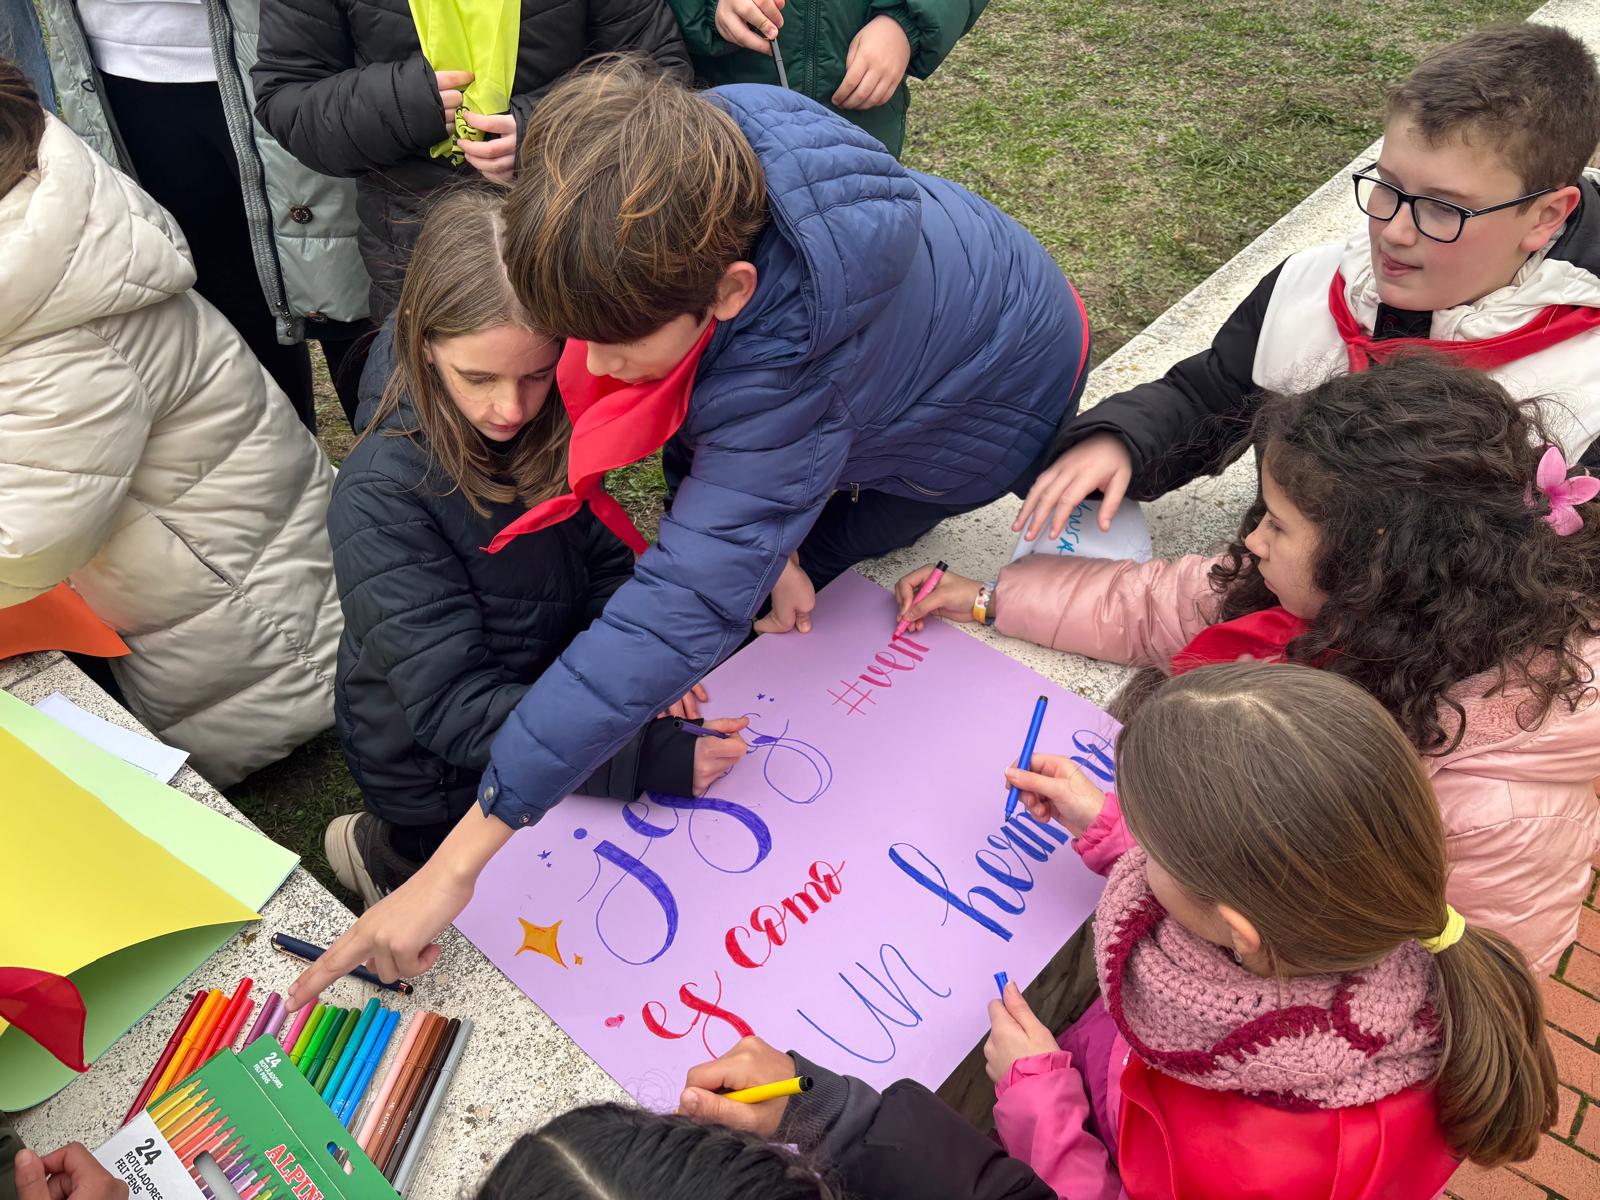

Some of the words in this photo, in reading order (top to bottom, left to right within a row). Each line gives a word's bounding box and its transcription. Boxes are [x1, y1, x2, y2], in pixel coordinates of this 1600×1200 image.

[725, 861, 845, 968] como
[797, 943, 951, 1063] un
[264, 1051, 282, 1068] 24
[134, 1137, 162, 1166] 24
[114, 1158, 131, 1175] FELT
[125, 1174, 143, 1195] PENS
